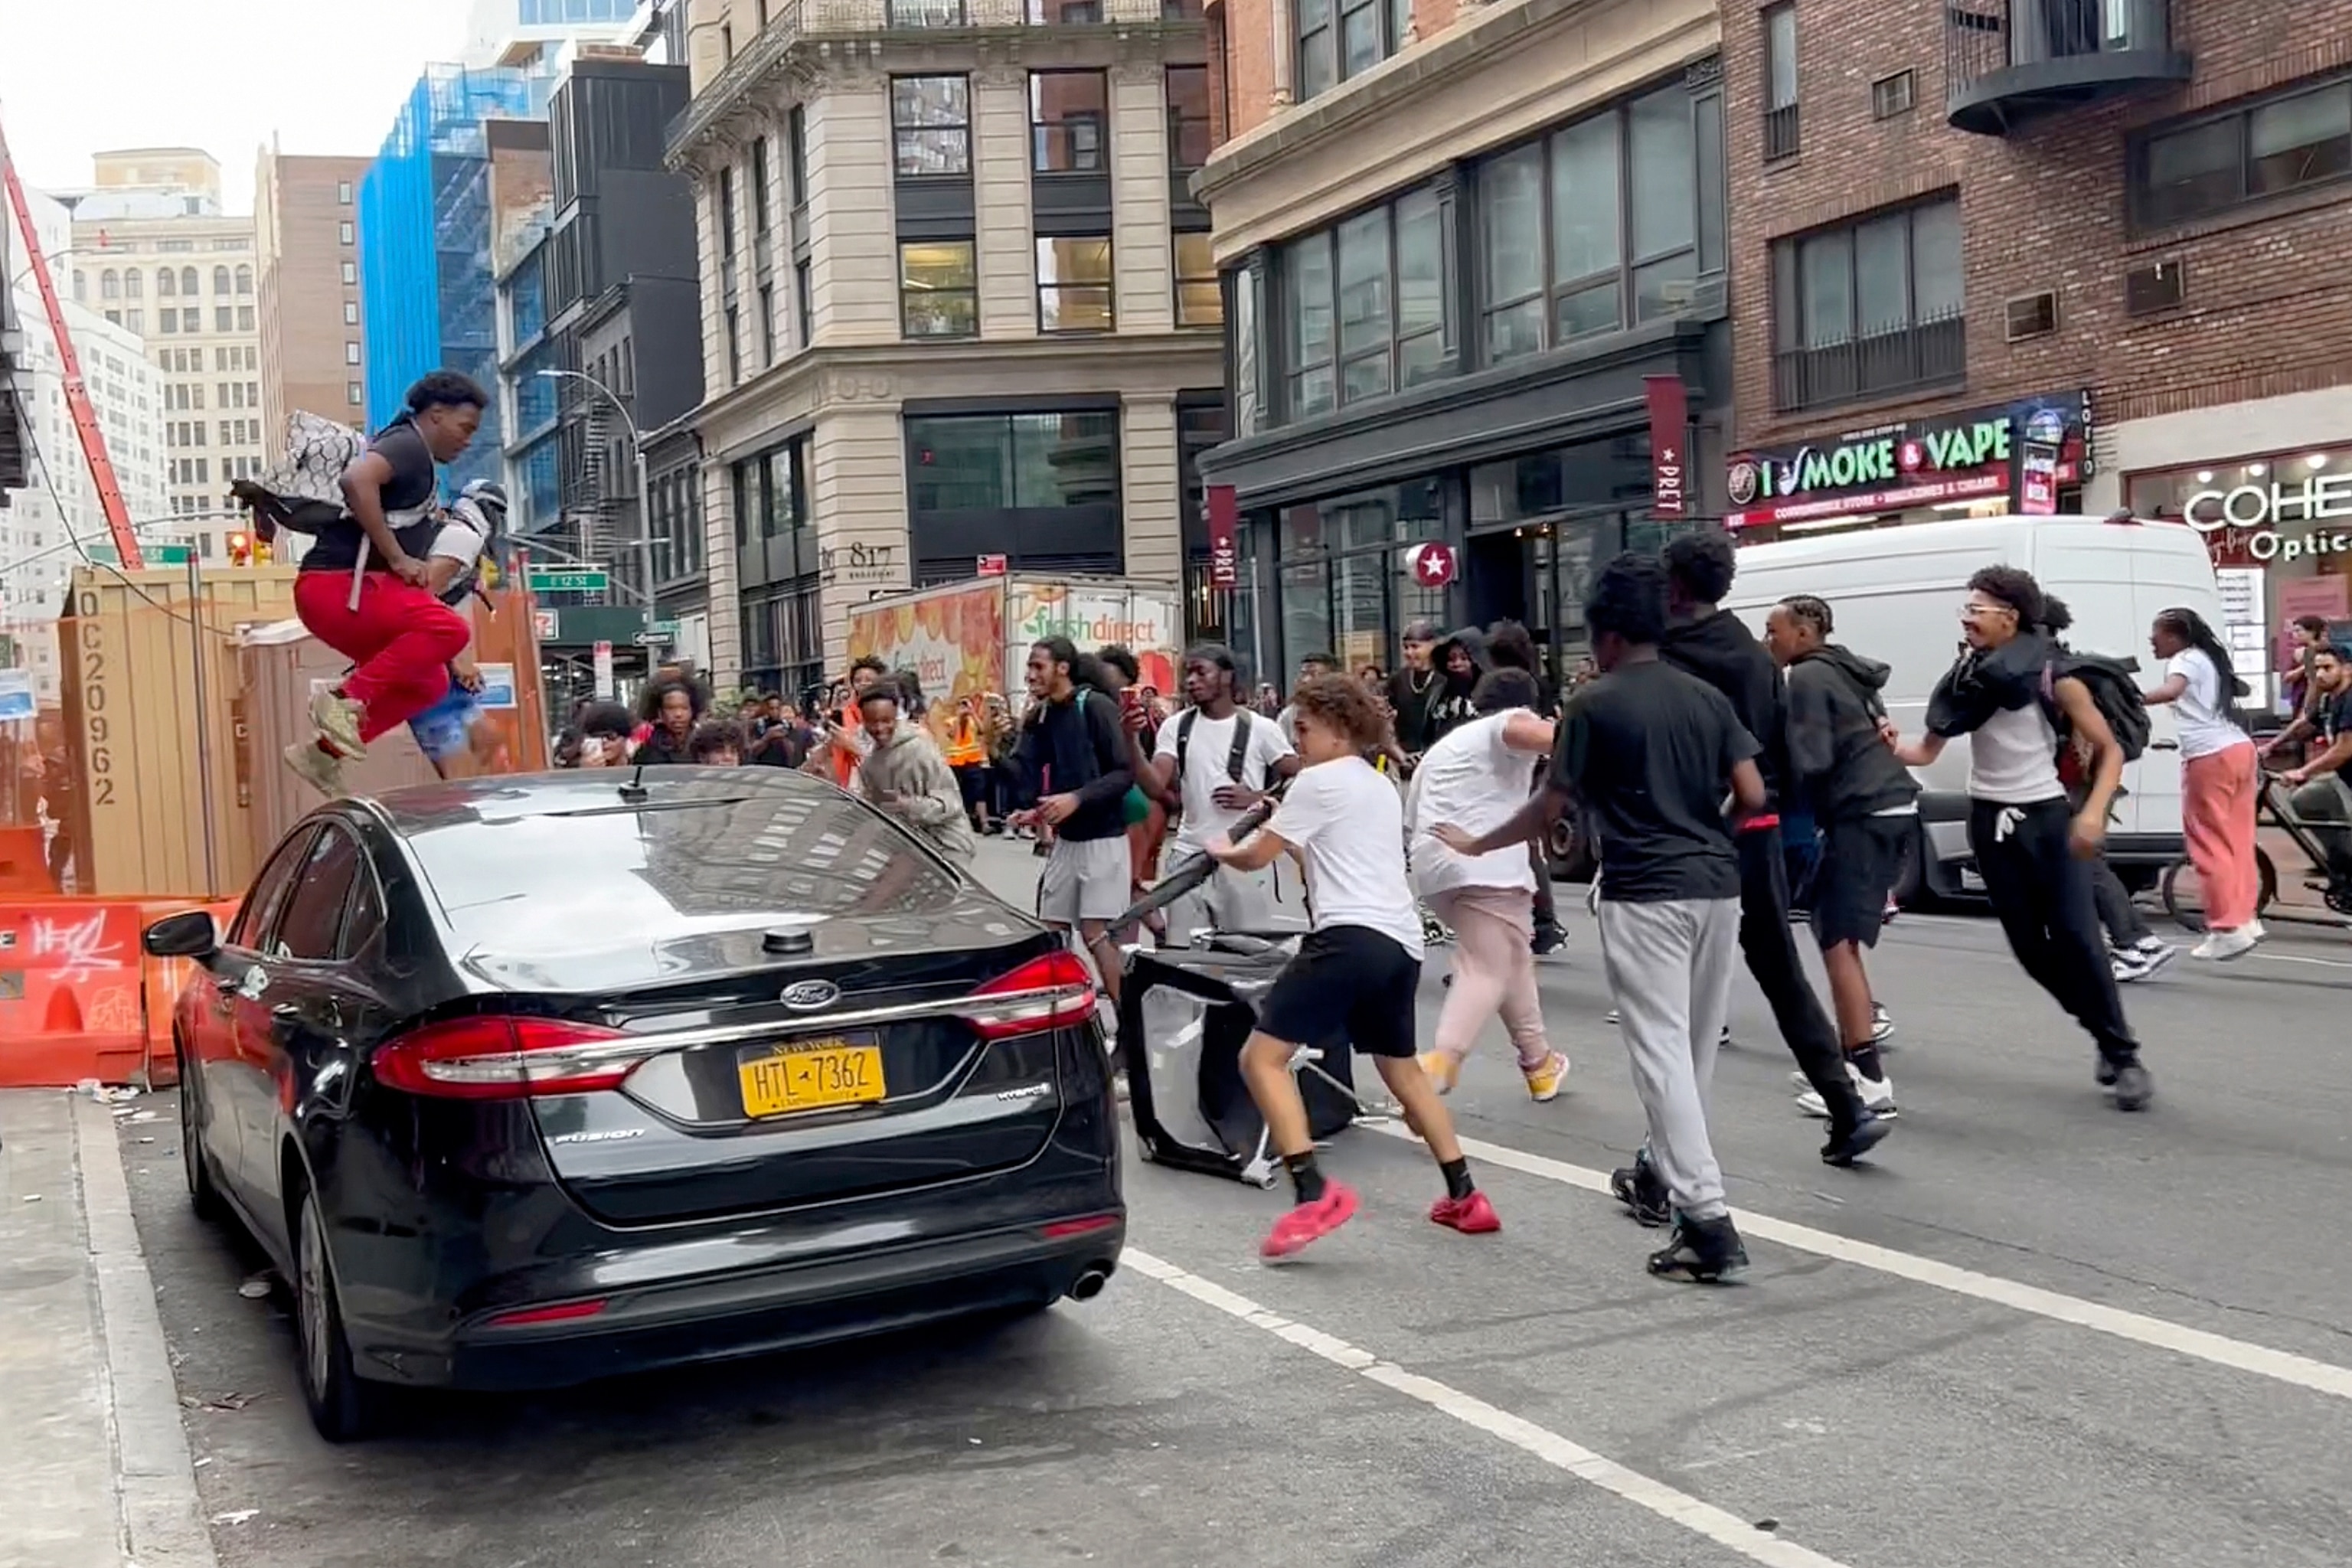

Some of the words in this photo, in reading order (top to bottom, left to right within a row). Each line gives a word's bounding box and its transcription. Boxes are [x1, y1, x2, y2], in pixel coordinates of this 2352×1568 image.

[2082, 390, 2095, 475] LOTTO
[1762, 460, 1772, 497] I
[1904, 443, 1919, 466] &
[1926, 417, 2010, 472] VAPE
[1658, 466, 1682, 511] PRET
[1843, 494, 1876, 511] STORE
[851, 541, 891, 567] 817
[2249, 530, 2352, 562] Optic
[1215, 549, 1236, 582] PRET
[790, 986, 828, 1003] Ford
[754, 1060, 799, 1101] HTL
[811, 1052, 870, 1093] 7362
